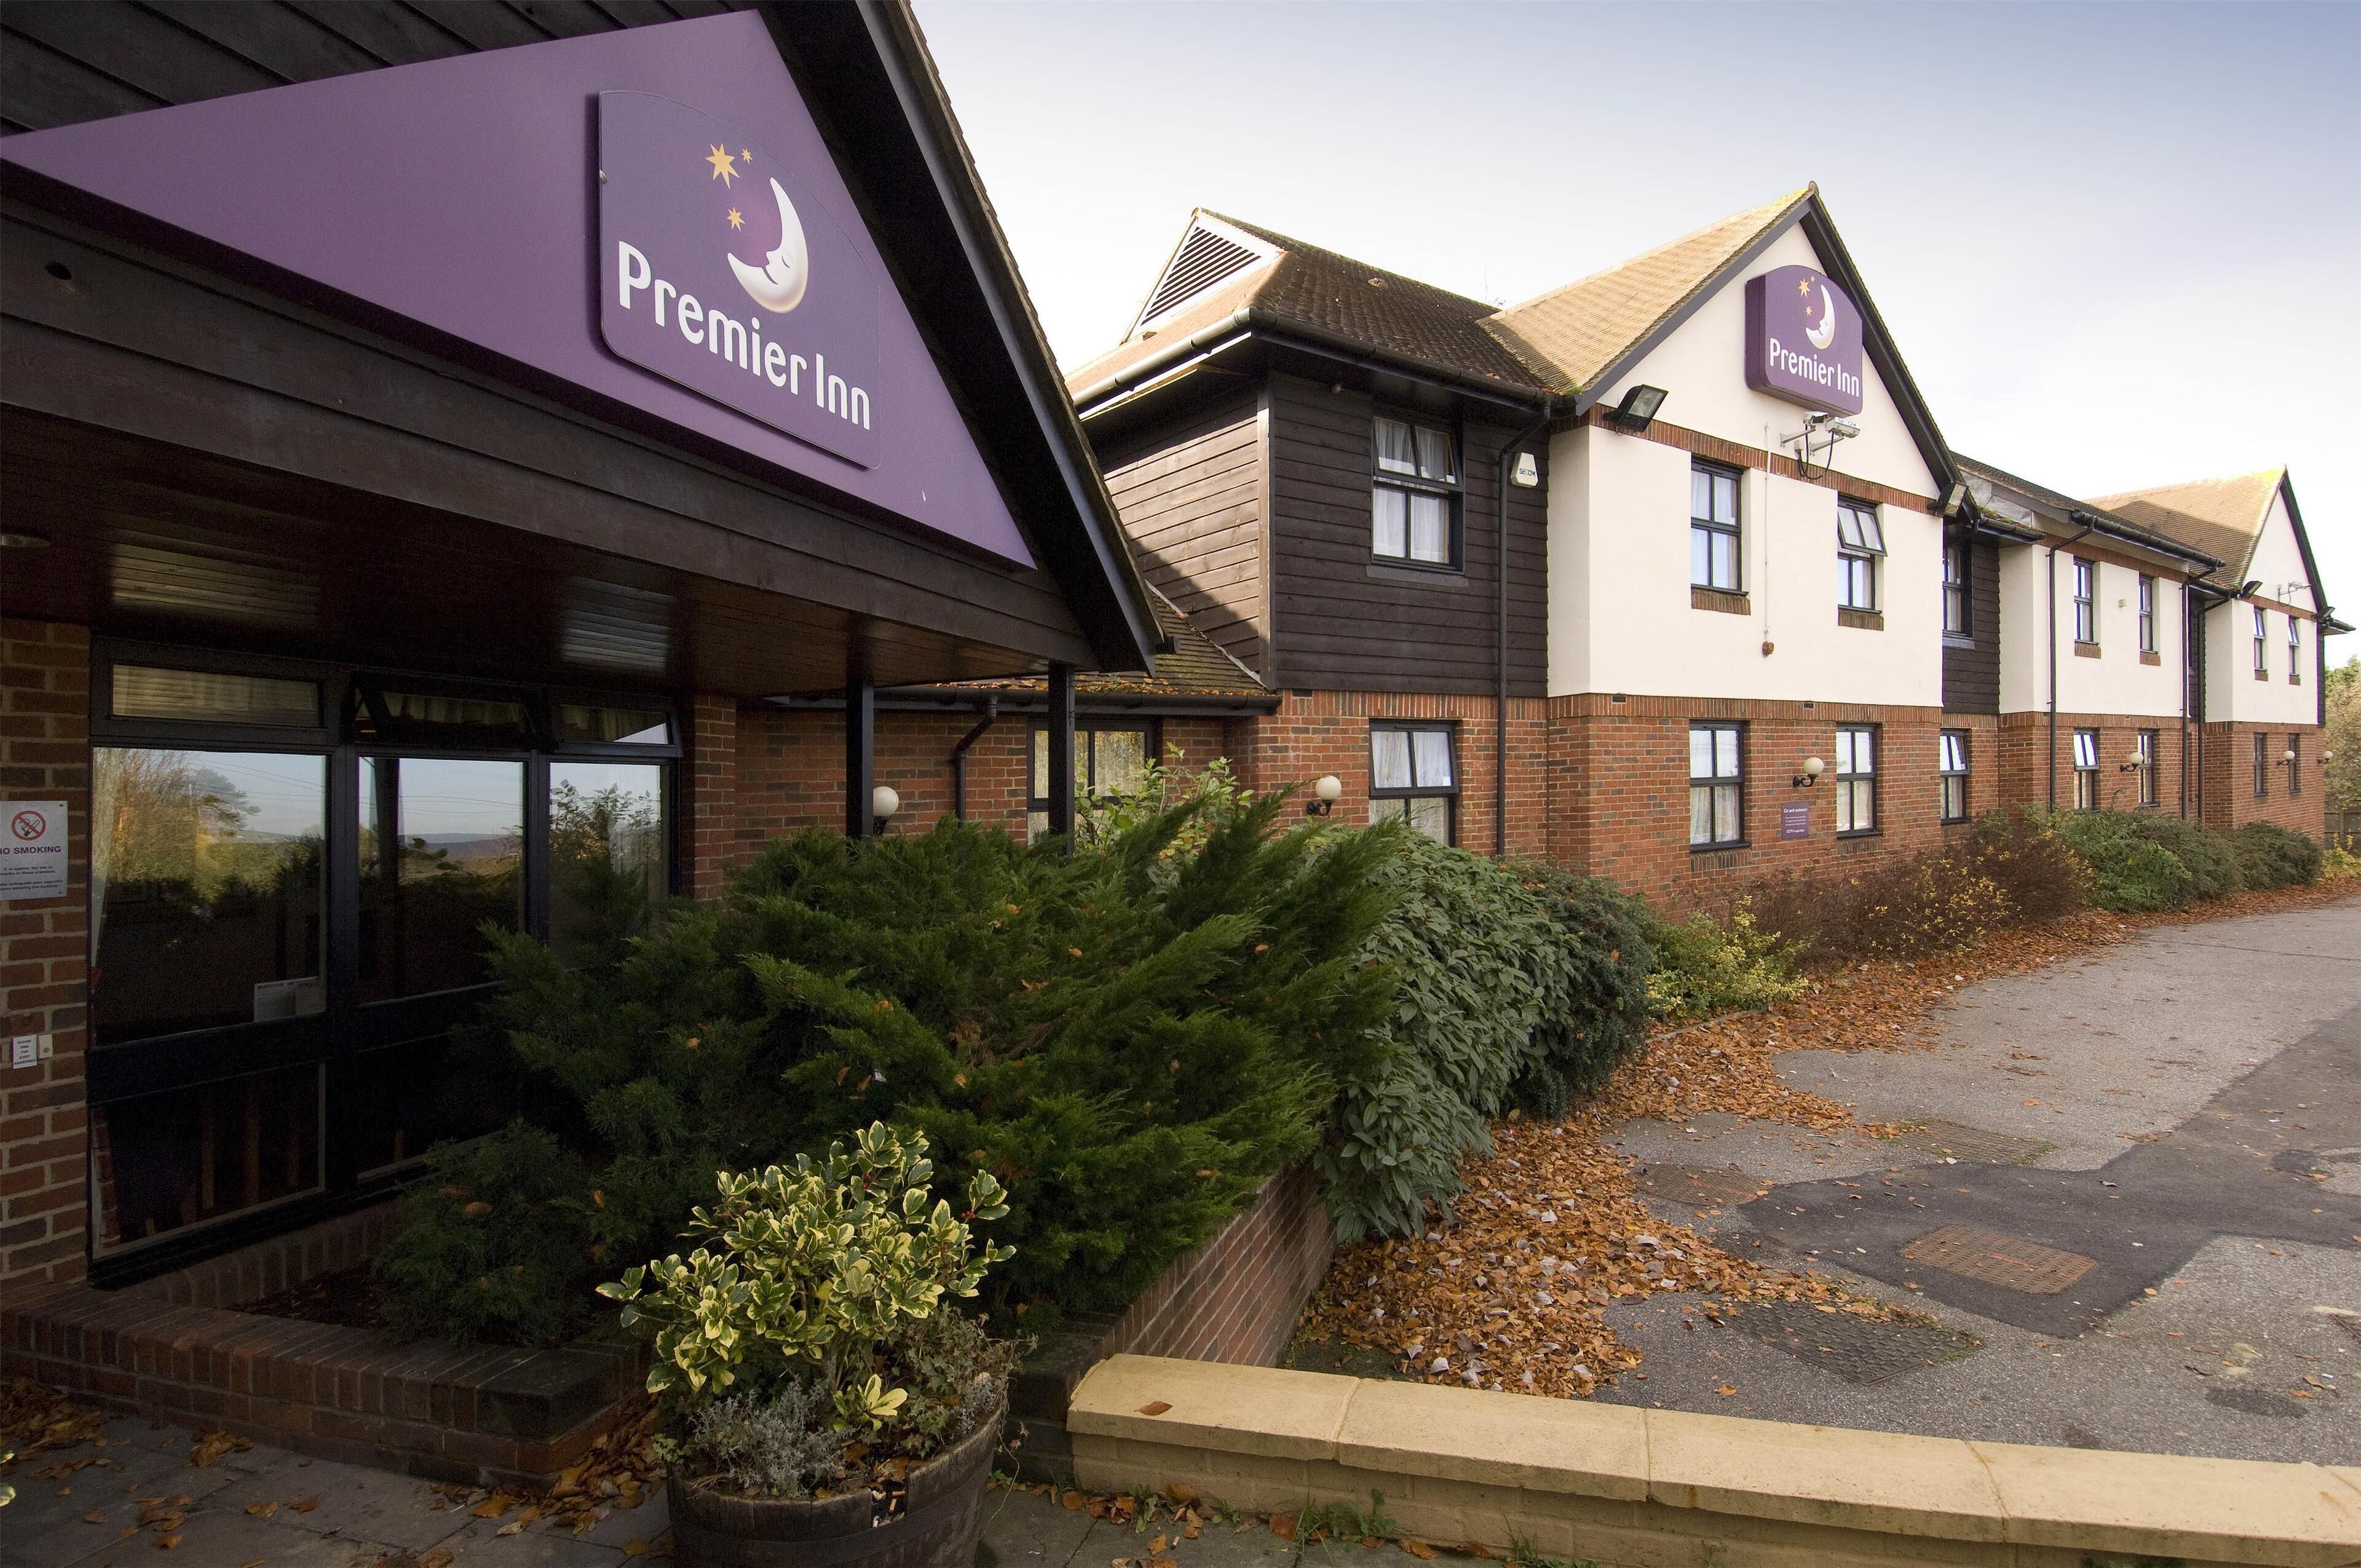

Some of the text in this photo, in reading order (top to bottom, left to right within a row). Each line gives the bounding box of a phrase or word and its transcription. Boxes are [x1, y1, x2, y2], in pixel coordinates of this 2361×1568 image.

[619, 240, 870, 430] Premier Inn
[1770, 338, 1859, 397] Premier Inn
